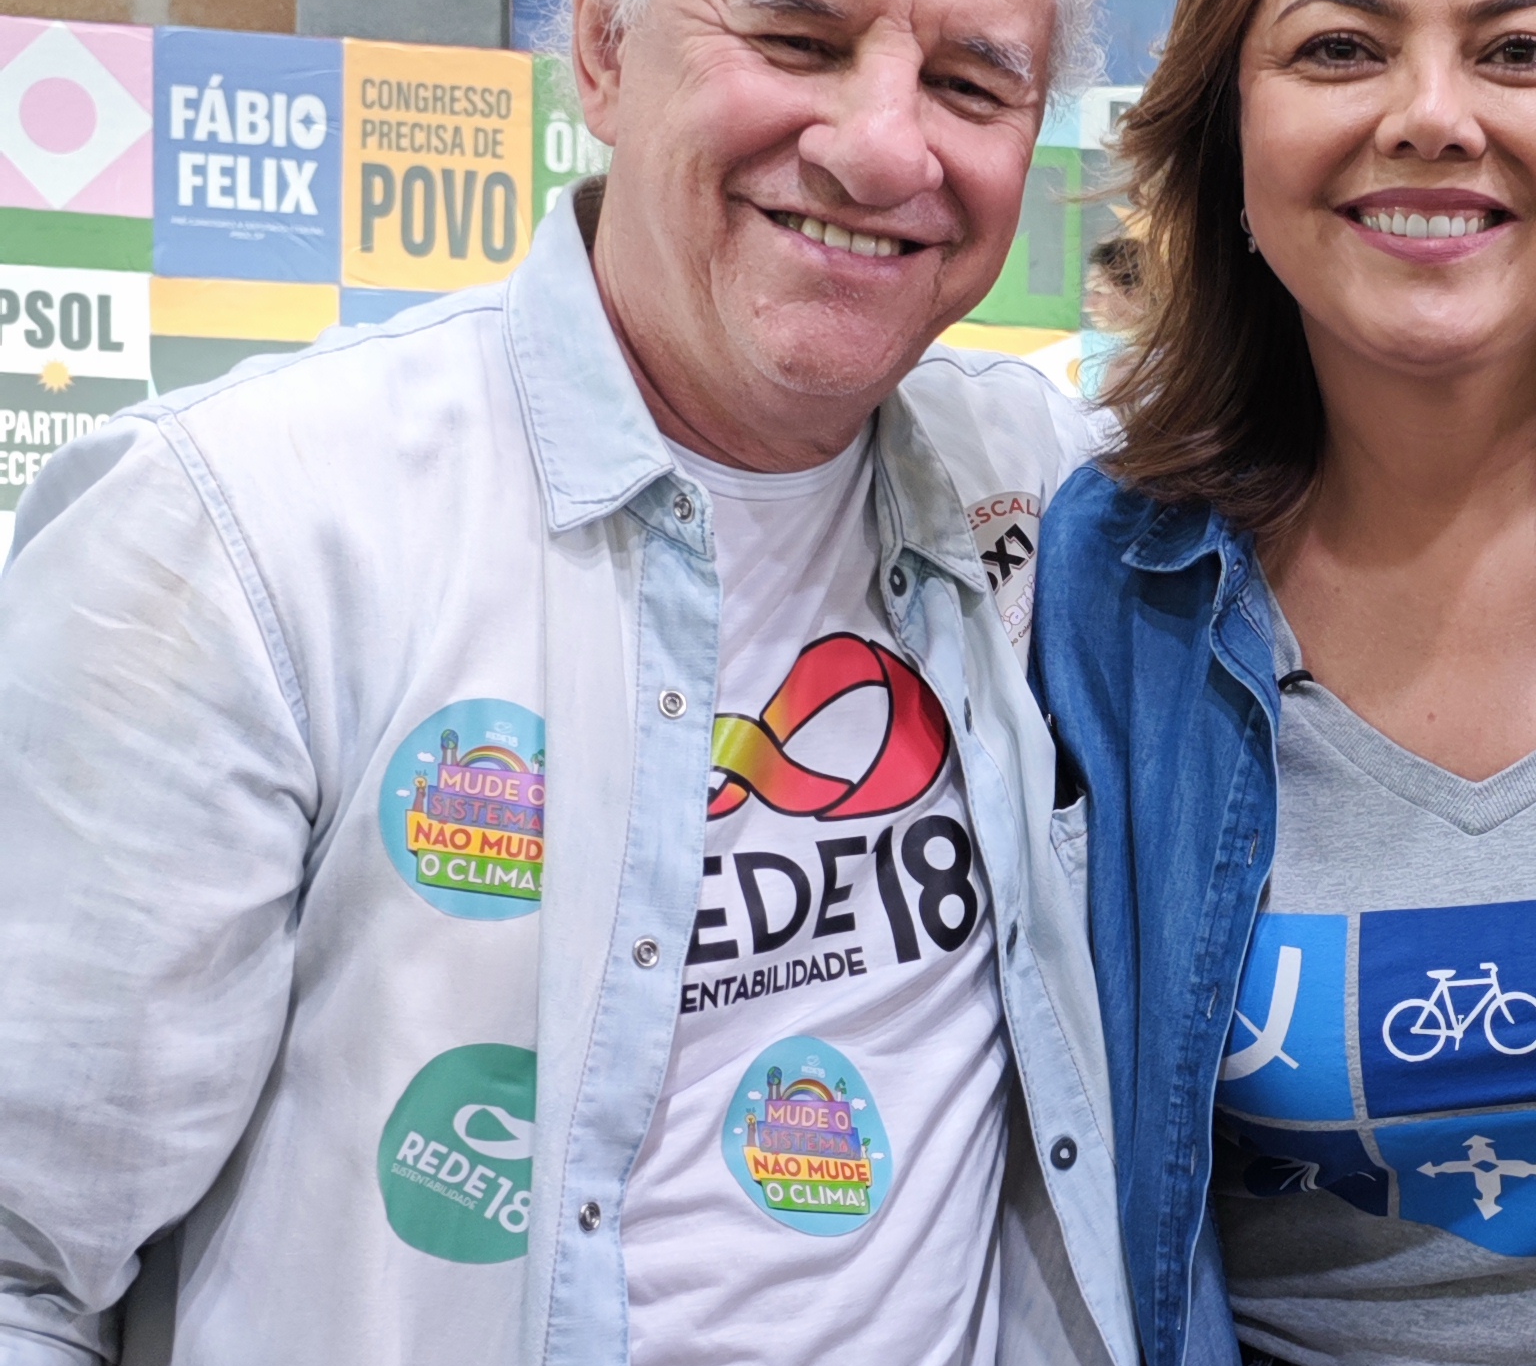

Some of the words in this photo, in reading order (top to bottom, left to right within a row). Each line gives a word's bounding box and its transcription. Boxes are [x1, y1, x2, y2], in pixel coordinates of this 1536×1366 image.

[169, 73, 328, 150] FÁBIO
[359, 77, 513, 121] CONGRESSO
[359, 119, 467, 158] PRECISA
[472, 127, 505, 161] DE
[177, 150, 320, 217] FELIX
[358, 161, 518, 264] POVO
[0, 288, 125, 353] PSOL
[439, 767, 521, 802] MUDE
[430, 793, 543, 832] SISTEMA
[413, 817, 472, 852] NÃO
[479, 831, 544, 862] MUD
[421, 853, 440, 877] O
[684, 815, 979, 967] EDE18
[766, 1104, 829, 1129] MUDE
[835, 1110, 850, 1131] O
[761, 1128, 850, 1154] SISTEMA
[396, 1130, 533, 1234] REDE18
[752, 1152, 802, 1178] NÃO
[807, 1158, 870, 1183] MUDE
[766, 1182, 784, 1202] O
[789, 1184, 867, 1208] CLIMA!
